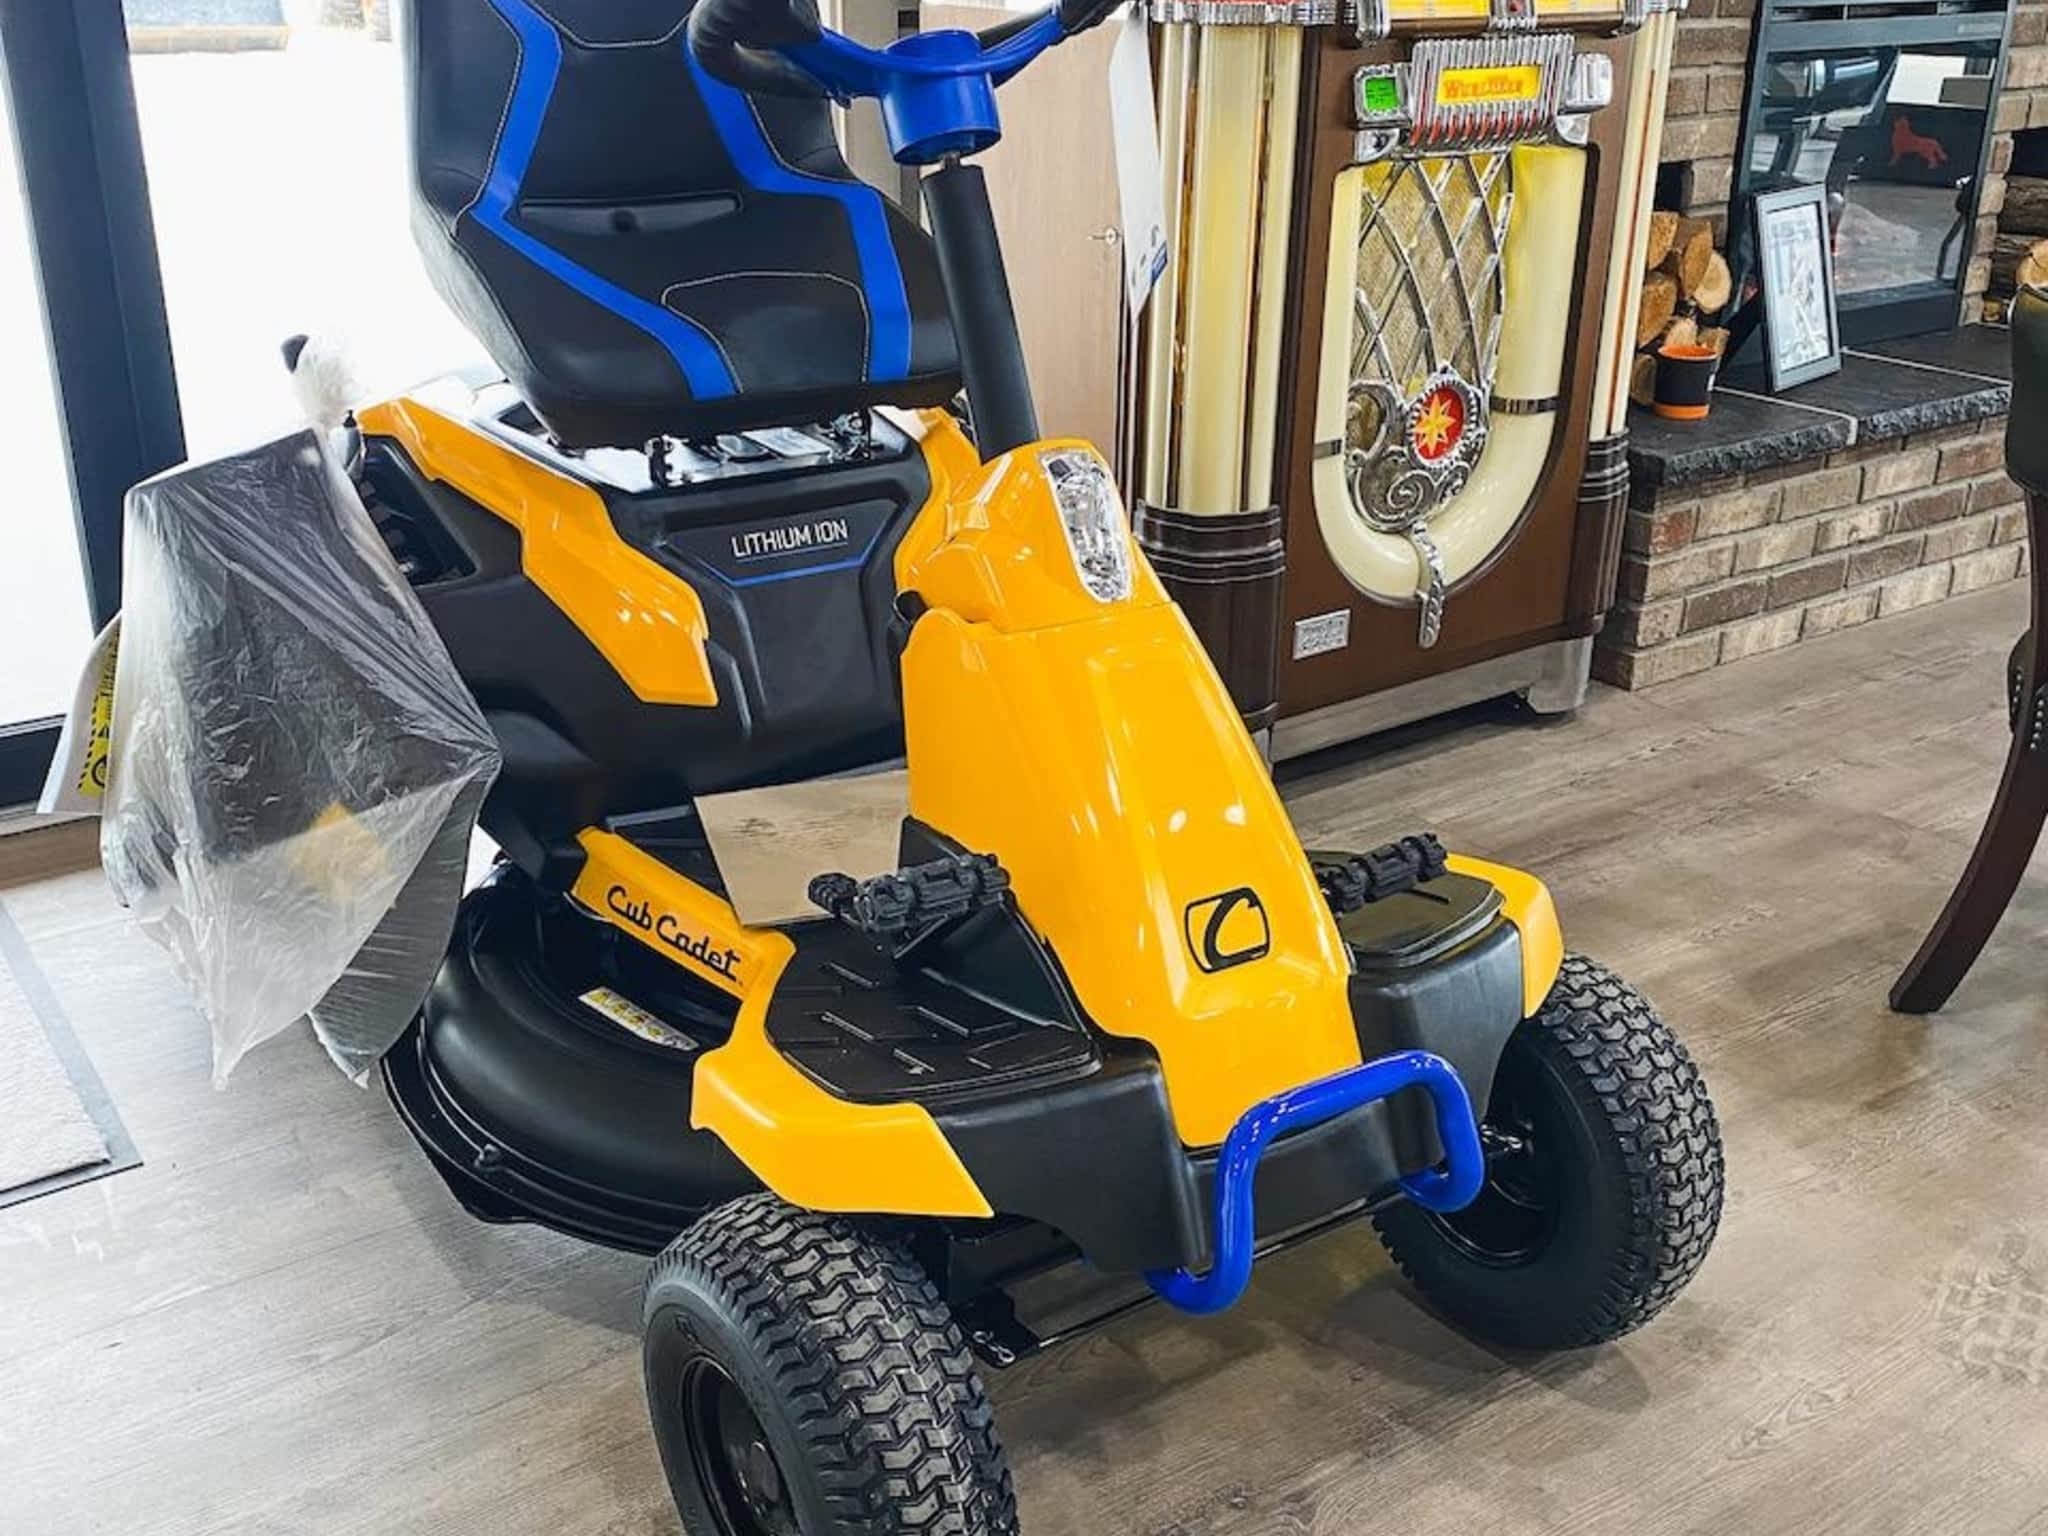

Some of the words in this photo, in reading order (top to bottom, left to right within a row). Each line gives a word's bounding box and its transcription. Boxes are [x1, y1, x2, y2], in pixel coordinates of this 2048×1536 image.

[731, 523, 812, 557] LITHIUM
[814, 519, 848, 543] ION
[607, 885, 652, 931] Cub
[656, 915, 741, 982] Cadet
